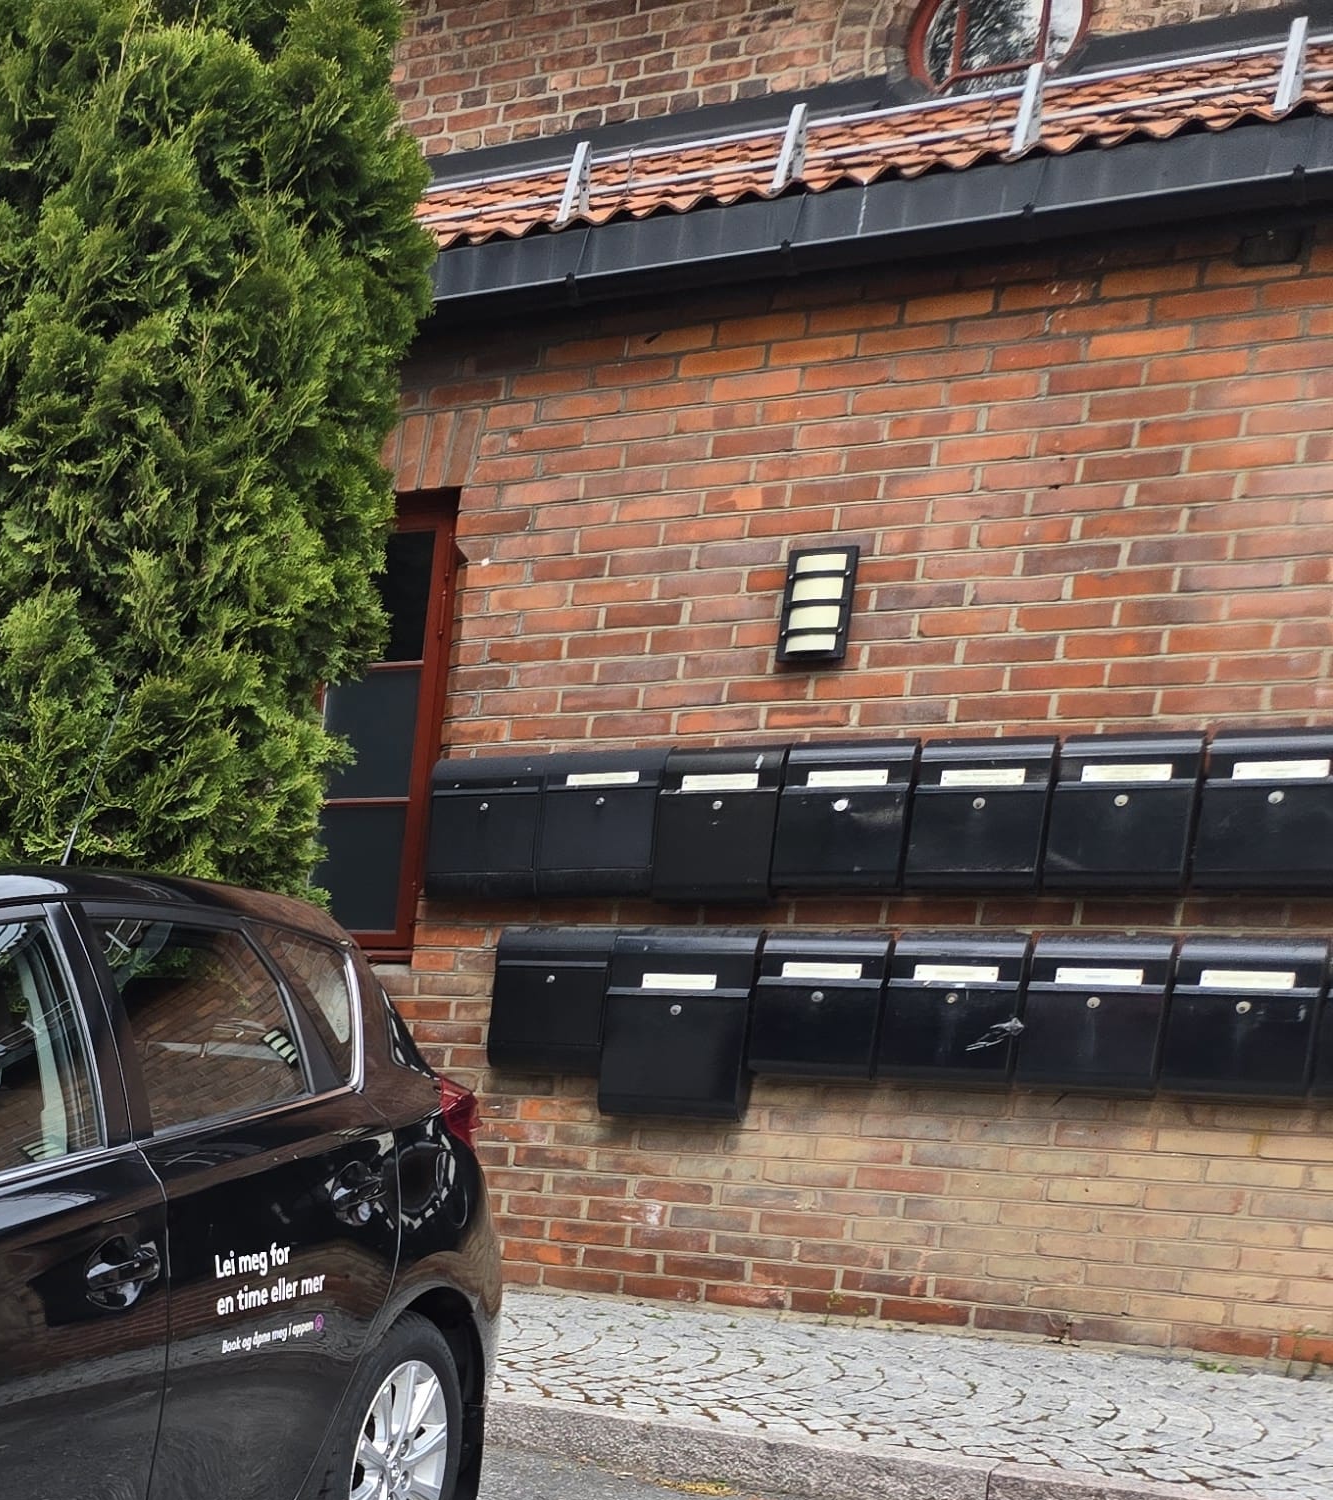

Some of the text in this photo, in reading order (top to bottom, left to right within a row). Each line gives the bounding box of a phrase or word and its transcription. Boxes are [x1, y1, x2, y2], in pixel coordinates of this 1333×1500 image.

[215, 1242, 290, 1279] Lei meg for
[217, 1274, 326, 1315] en time eller mer
[221, 1336, 241, 1354] Book
[241, 1337, 252, 1351] og
[272, 1327, 287, 1342] meg
[292, 1321, 314, 1338] appen
